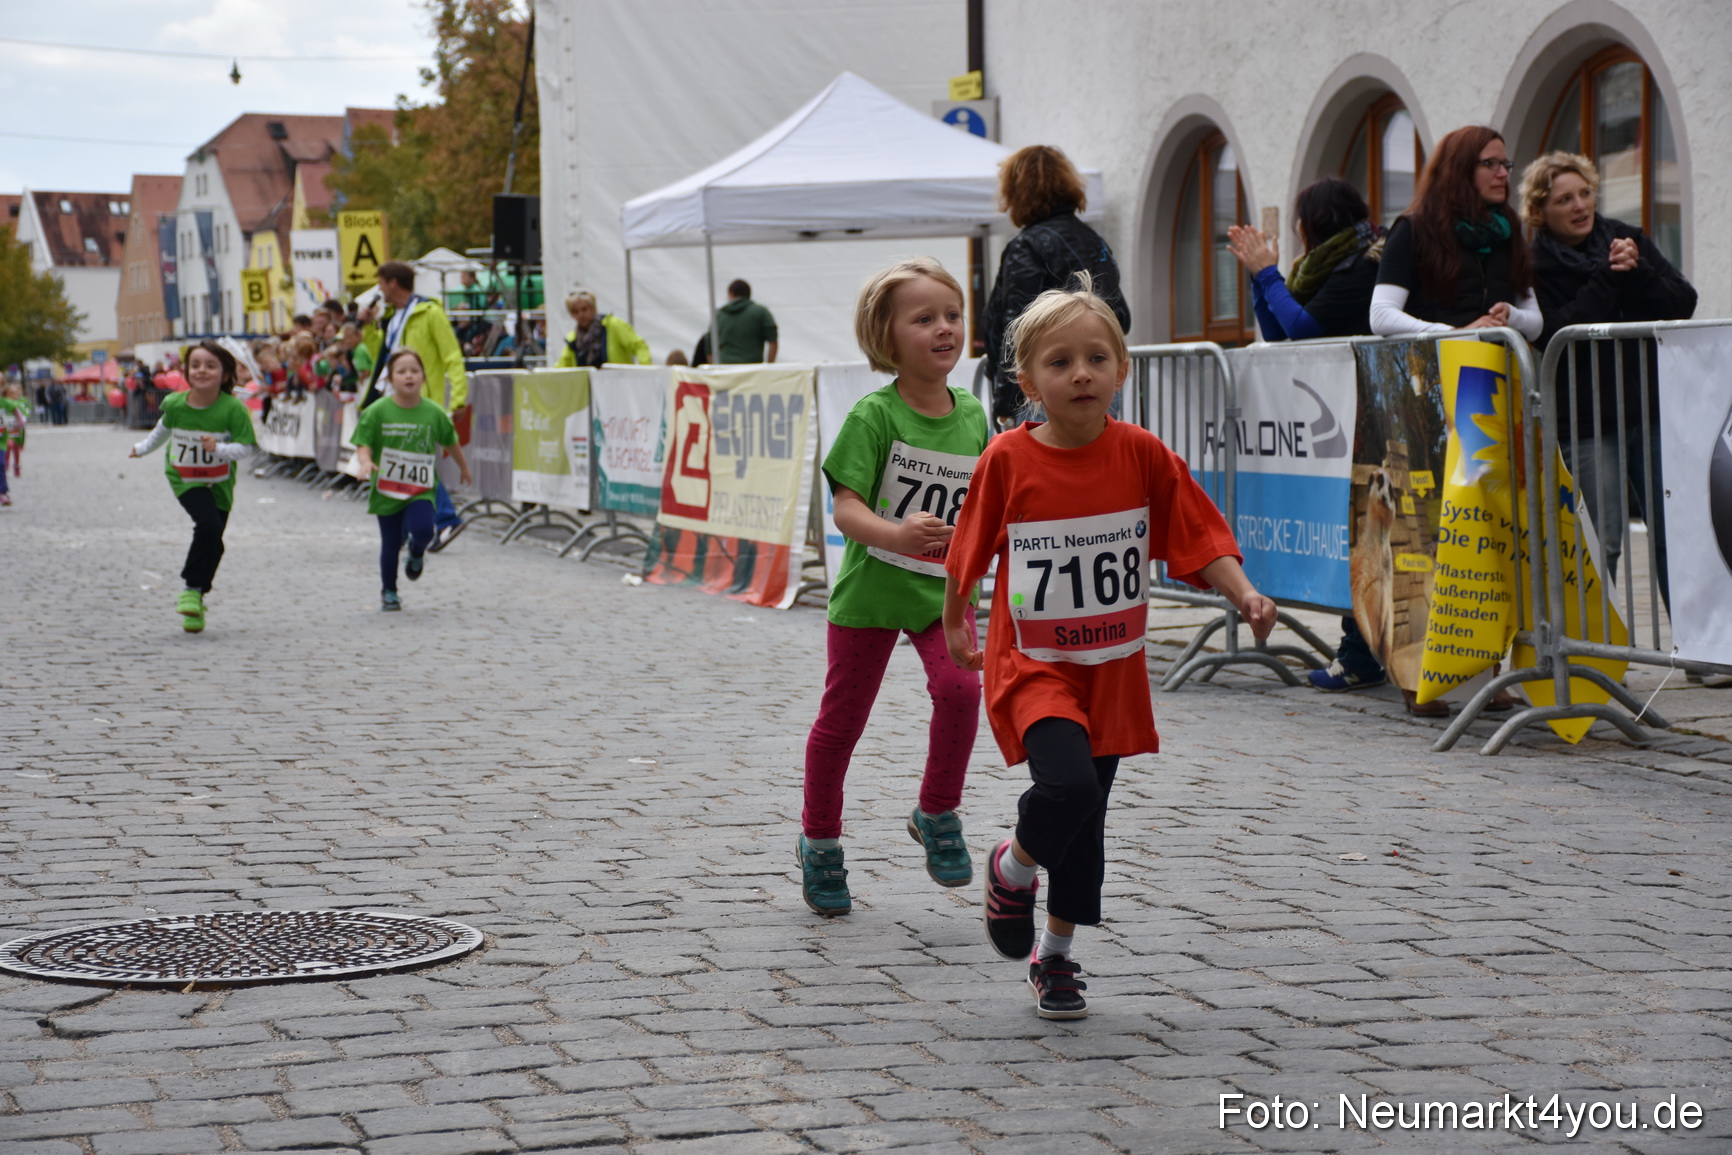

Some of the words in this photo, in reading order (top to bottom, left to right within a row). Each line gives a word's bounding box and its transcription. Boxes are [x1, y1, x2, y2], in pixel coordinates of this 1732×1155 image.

[344, 214, 382, 228] Block
[352, 234, 378, 267] A
[248, 282, 263, 303] B
[711, 389, 804, 479] Egner
[386, 460, 428, 484] 7140
[891, 453, 934, 475] PARTL
[1013, 536, 1061, 552] PARTL
[1064, 527, 1132, 548] Neumarkt
[1237, 515, 1292, 553] STRECKE
[1295, 521, 1350, 561] ZUHAUSE
[1437, 526, 1470, 547] Die
[1026, 546, 1140, 612] 7168
[1431, 602, 1499, 621] Palisaden
[1055, 622, 1127, 646] Sabrina
[1429, 619, 1474, 638] Stufen
